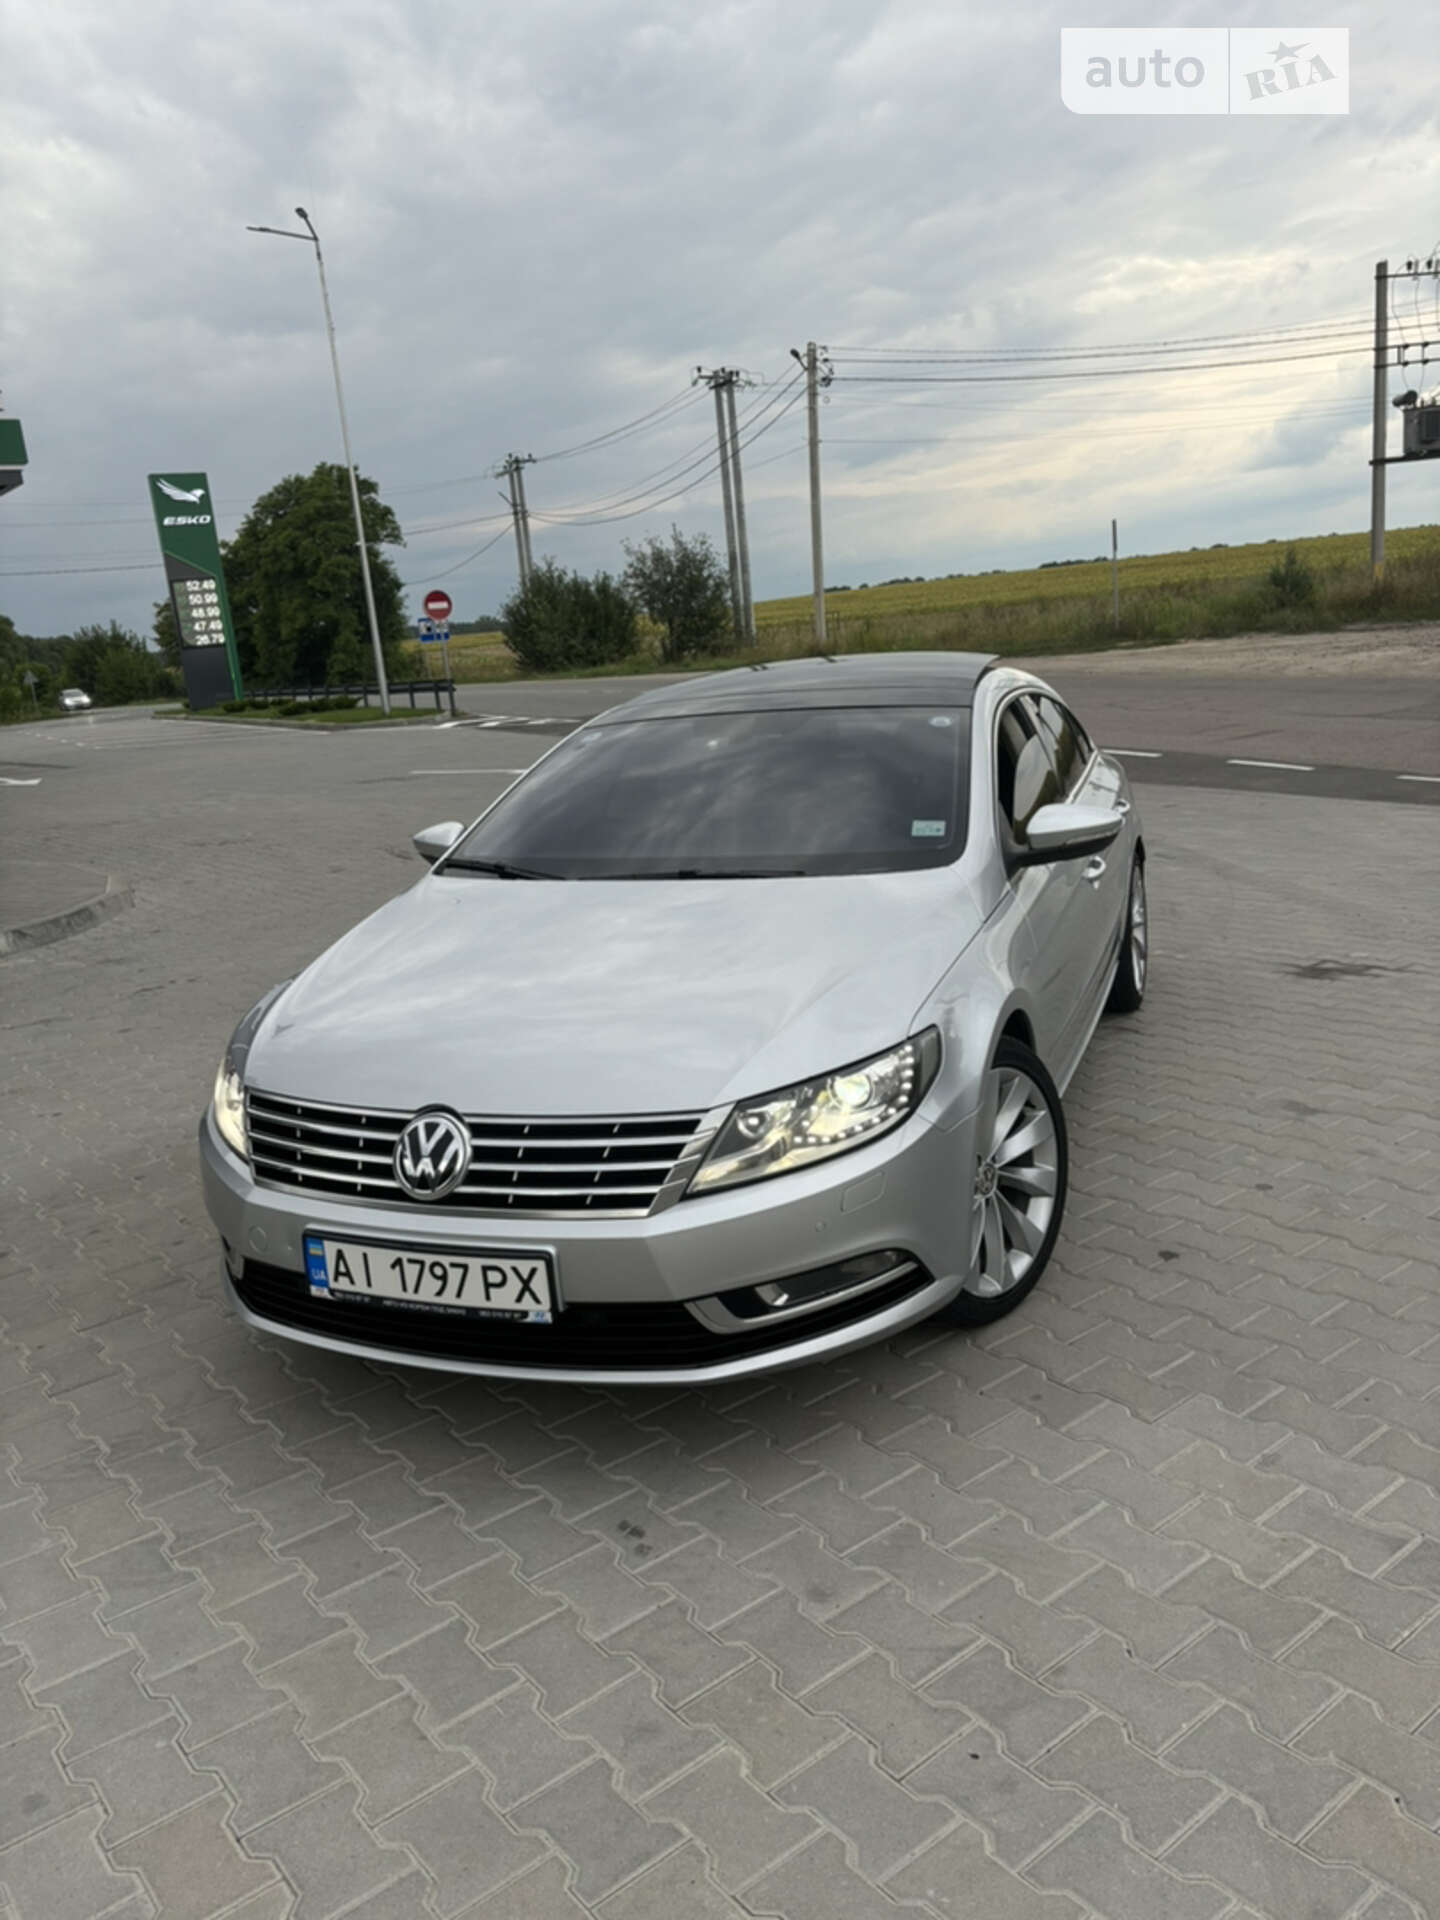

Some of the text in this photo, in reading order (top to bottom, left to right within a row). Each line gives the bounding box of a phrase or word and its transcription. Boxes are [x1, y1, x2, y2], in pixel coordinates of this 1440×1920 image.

[163, 515, 211, 526] ESKO
[334, 1248, 542, 1304] AI 1797 PX
